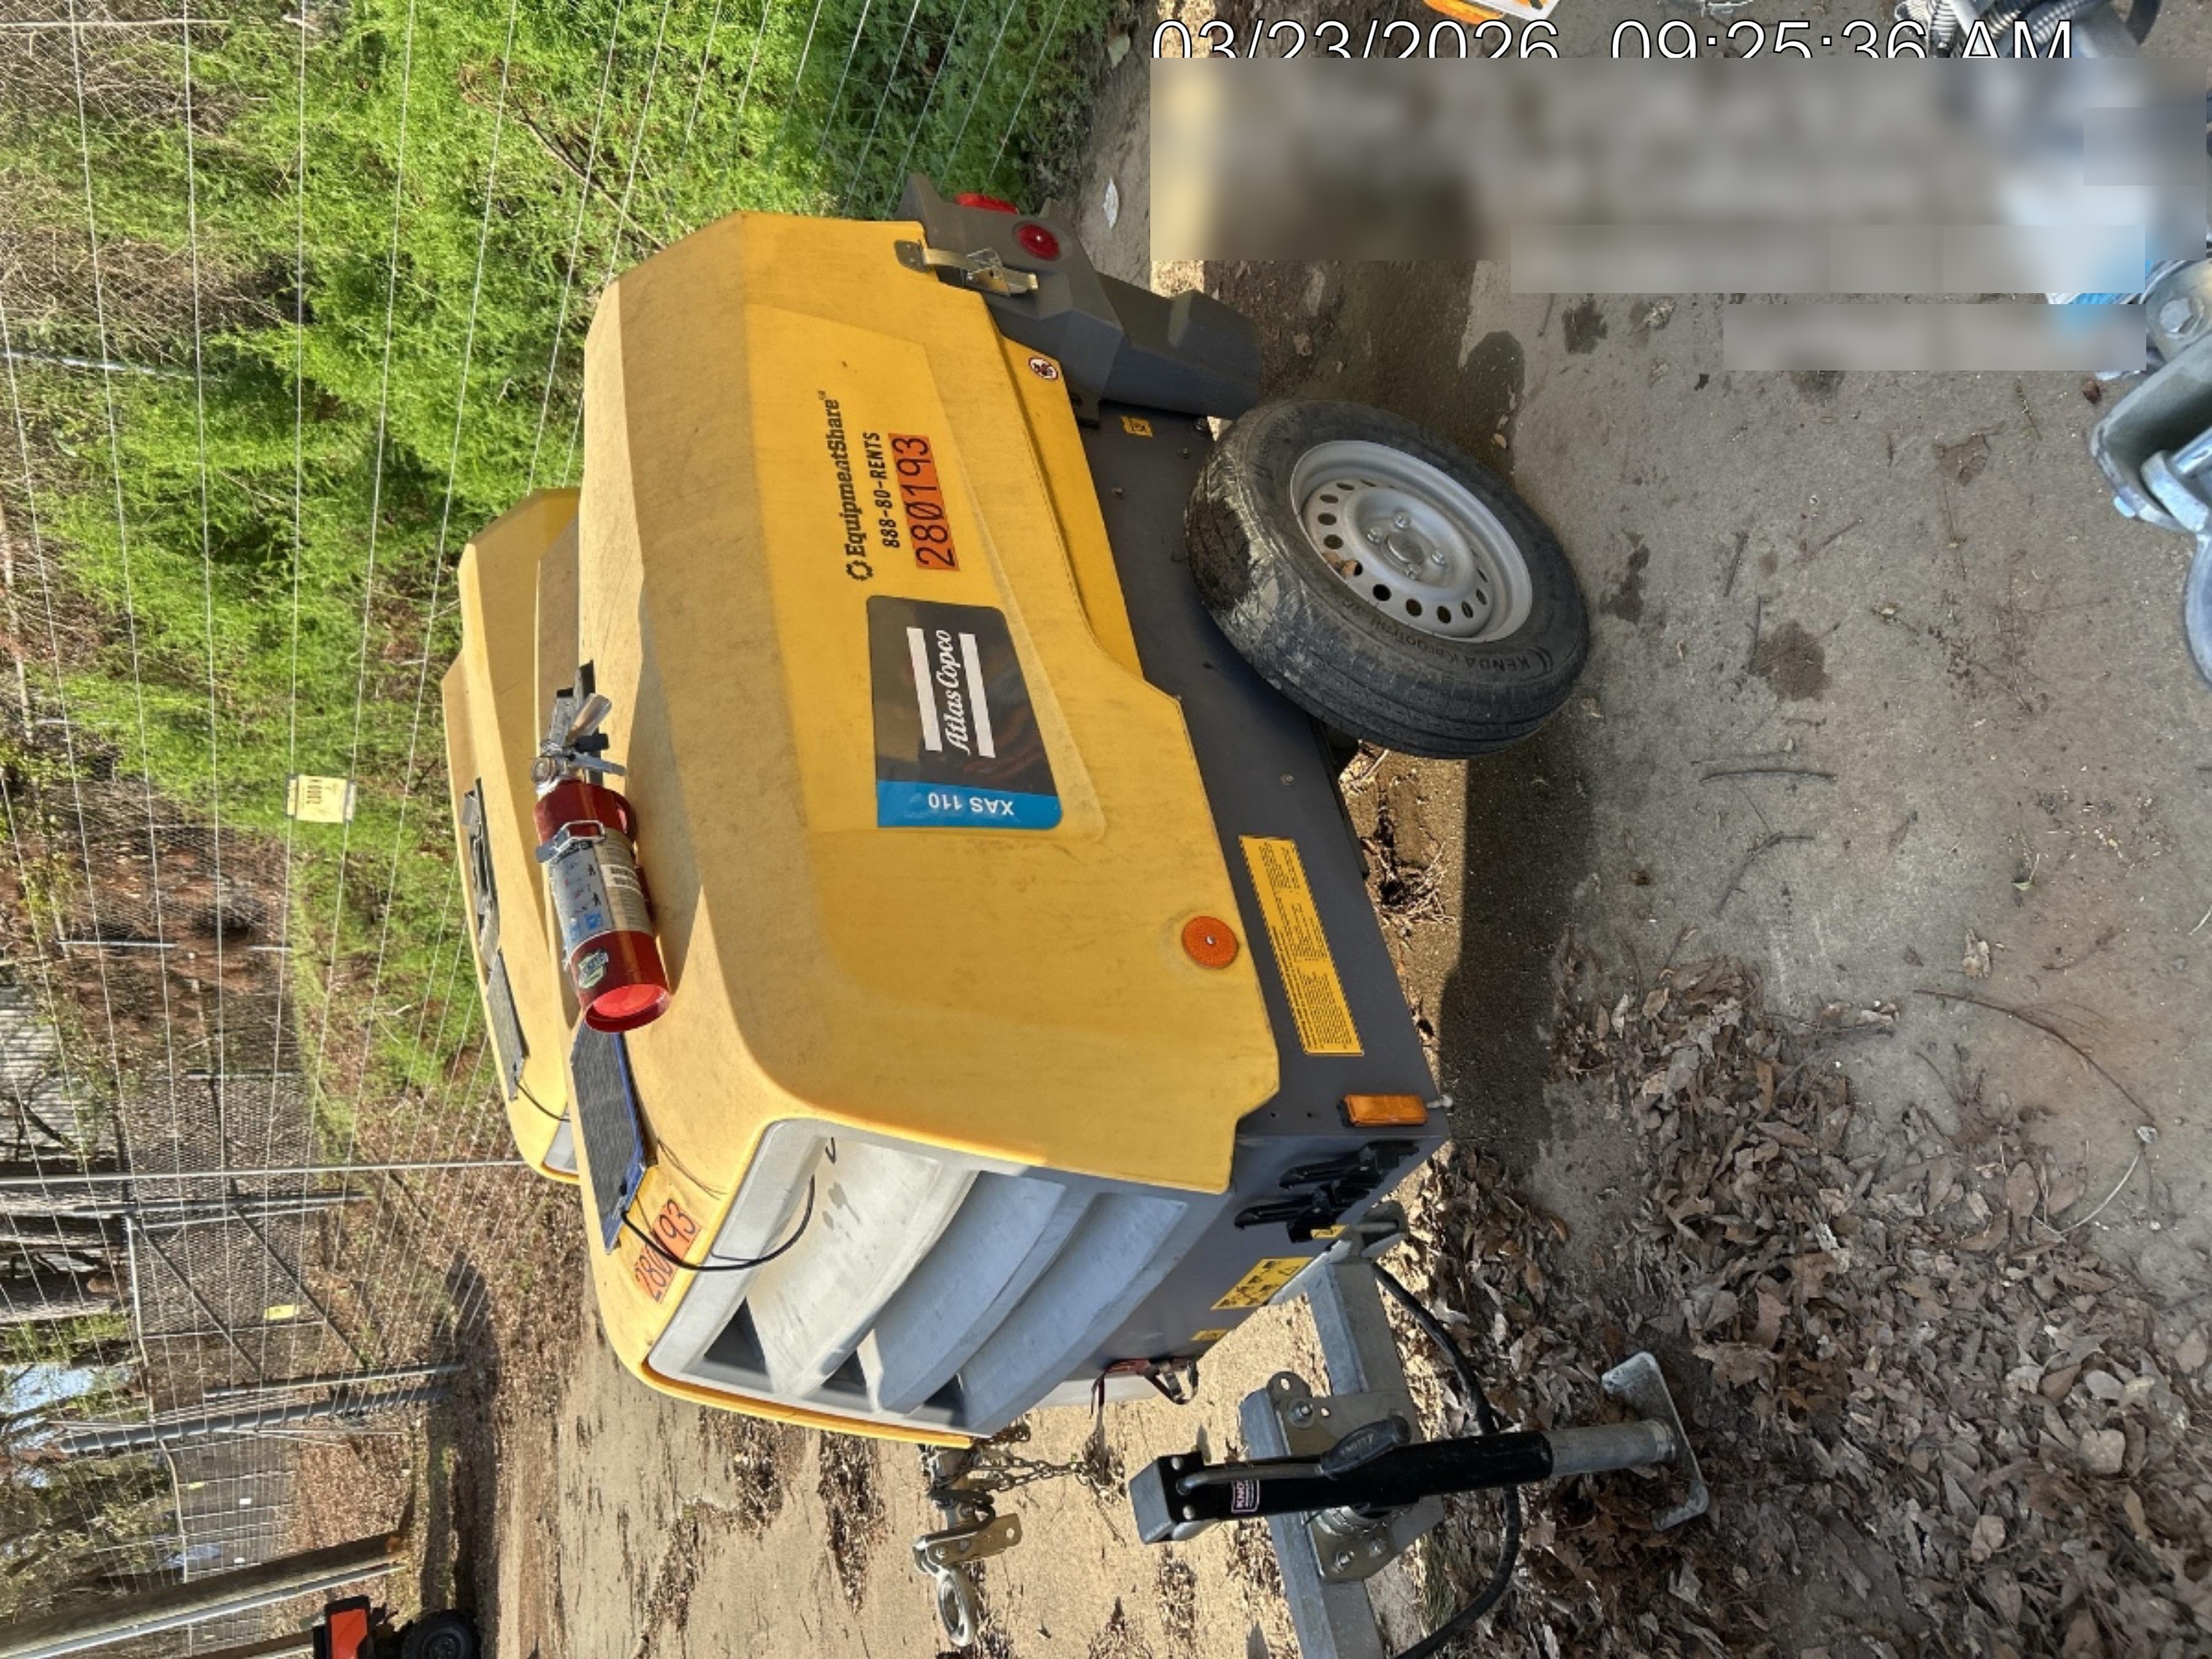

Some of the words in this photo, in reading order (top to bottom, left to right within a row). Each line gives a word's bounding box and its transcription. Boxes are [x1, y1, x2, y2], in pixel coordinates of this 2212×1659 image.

[825, 399, 866, 557] EquipmentShare
[863, 431, 900, 547] 888-80-RENTS
[892, 437, 955, 566] 280193
[936, 629, 961, 688] Copco
[943, 688, 971, 755] Atlas
[928, 791, 963, 809] 110
[969, 797, 1014, 815] XAS
[634, 1198, 696, 1301] 28093
